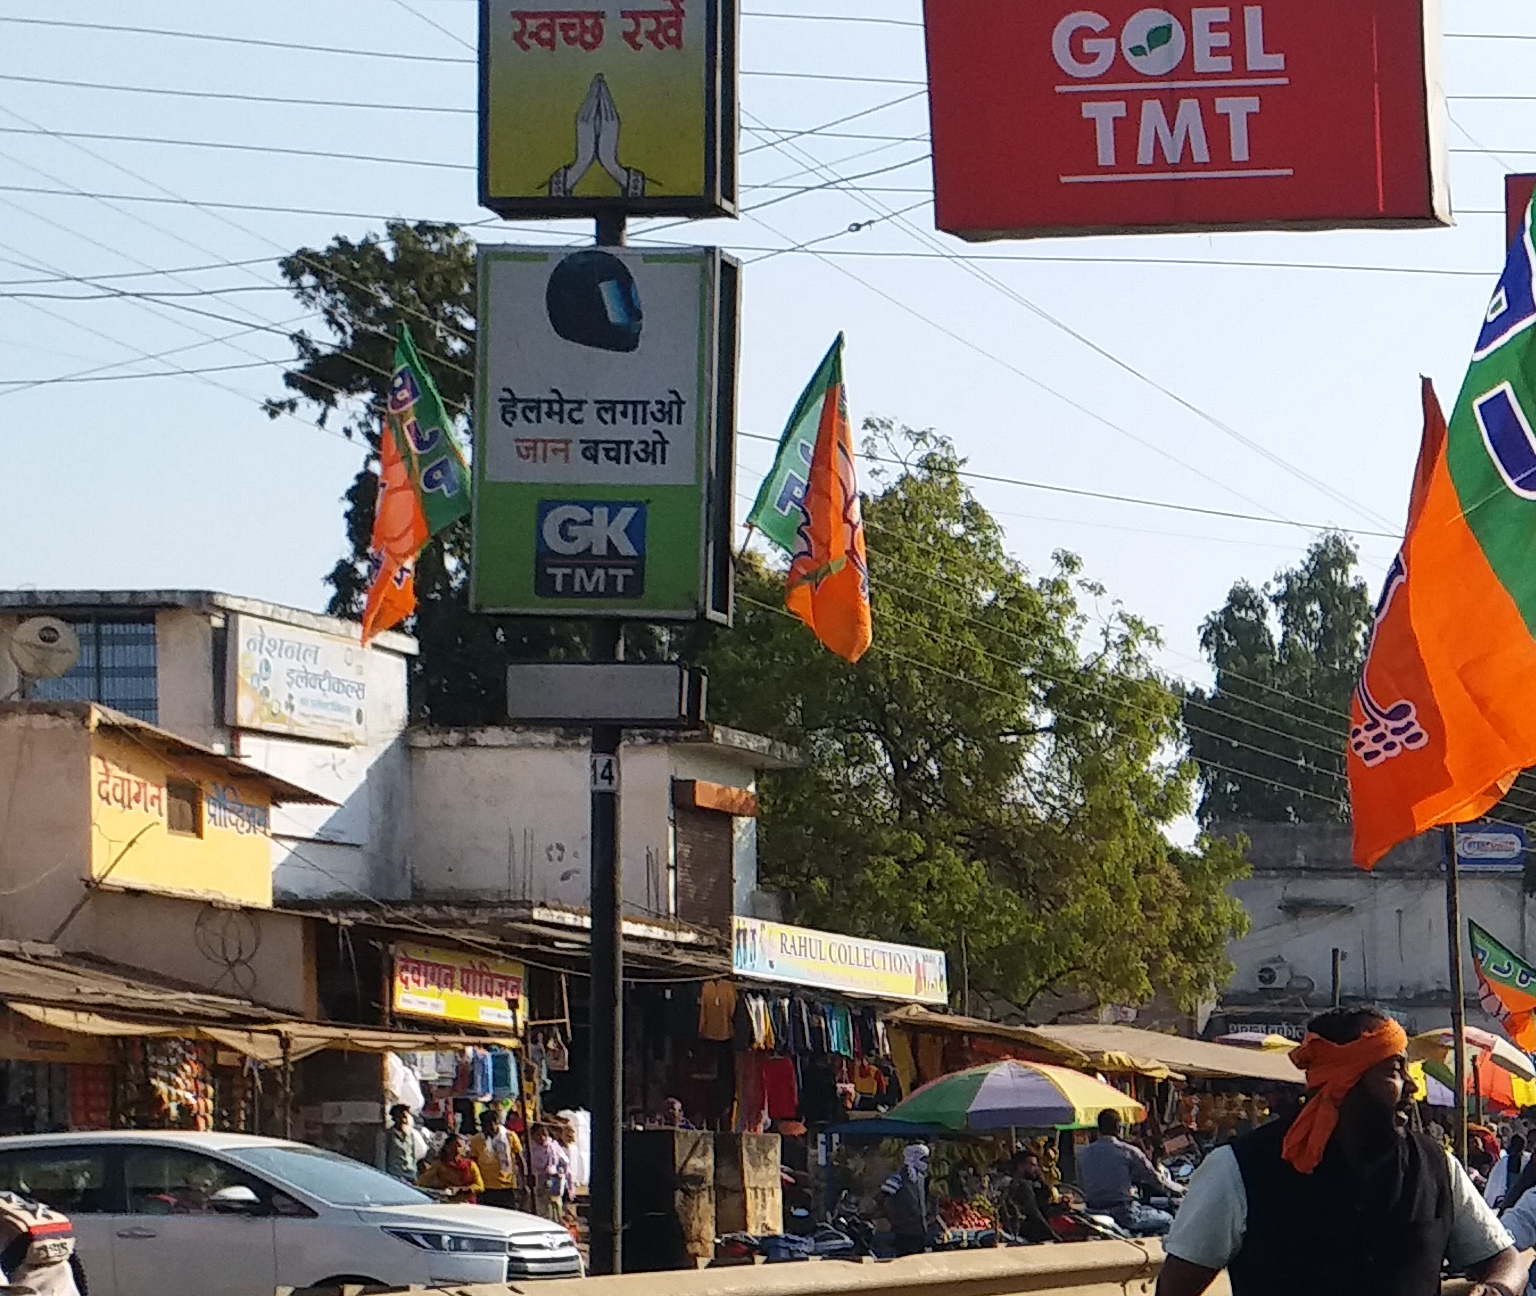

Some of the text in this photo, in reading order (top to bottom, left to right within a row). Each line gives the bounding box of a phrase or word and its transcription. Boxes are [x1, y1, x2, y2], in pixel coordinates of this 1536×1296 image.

[510, 10, 606, 51] स्वच्छ
[1051, 5, 1286, 79] GOEL
[1082, 96, 1260, 166] TMT
[498, 387, 686, 427] हेलमेट लगाओ
[514, 429, 669, 466] जान बचाओ
[541, 503, 641, 558] GK
[547, 566, 634, 595] TMT
[246, 624, 320, 666] नेशनल
[780, 931, 913, 975] RAHUL COLLECTION
